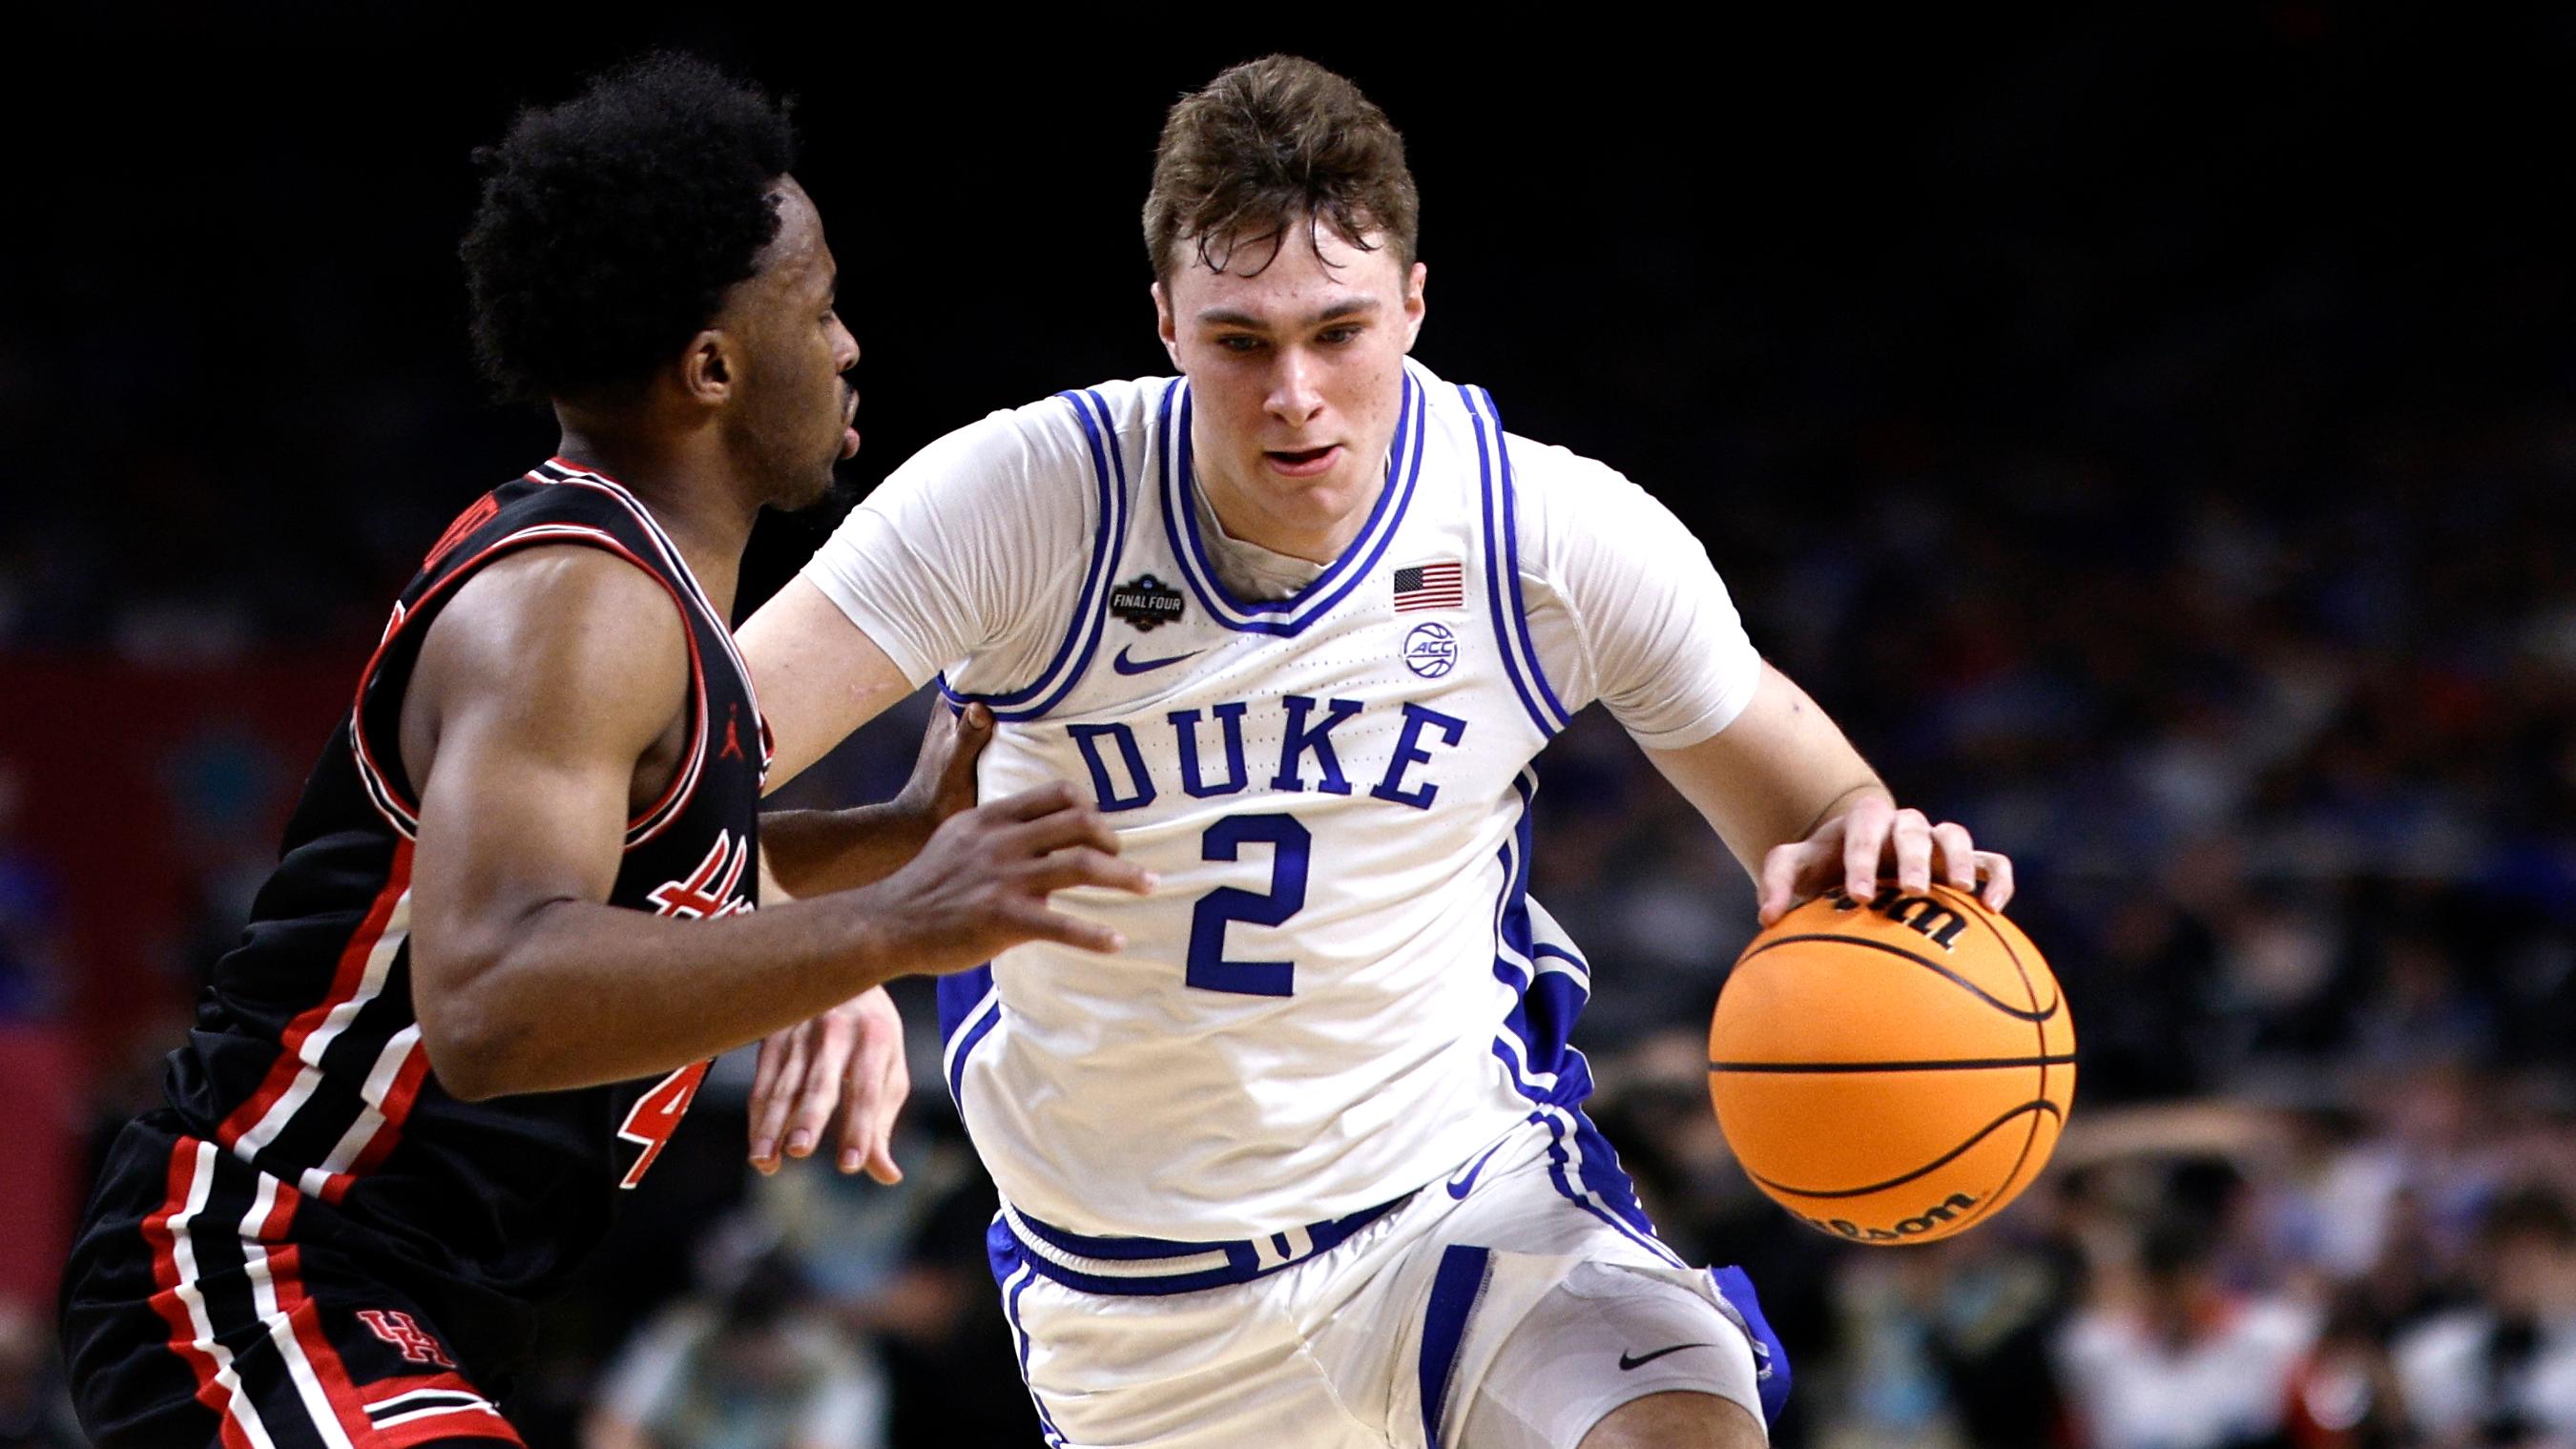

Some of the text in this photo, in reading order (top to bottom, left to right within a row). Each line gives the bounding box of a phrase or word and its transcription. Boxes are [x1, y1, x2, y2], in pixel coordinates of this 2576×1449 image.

[1113, 593, 1182, 611] FINAL FOUR
[1411, 640, 1456, 653] ACC
[1066, 694, 1467, 813] DUKE
[1186, 813, 1312, 998] 2
